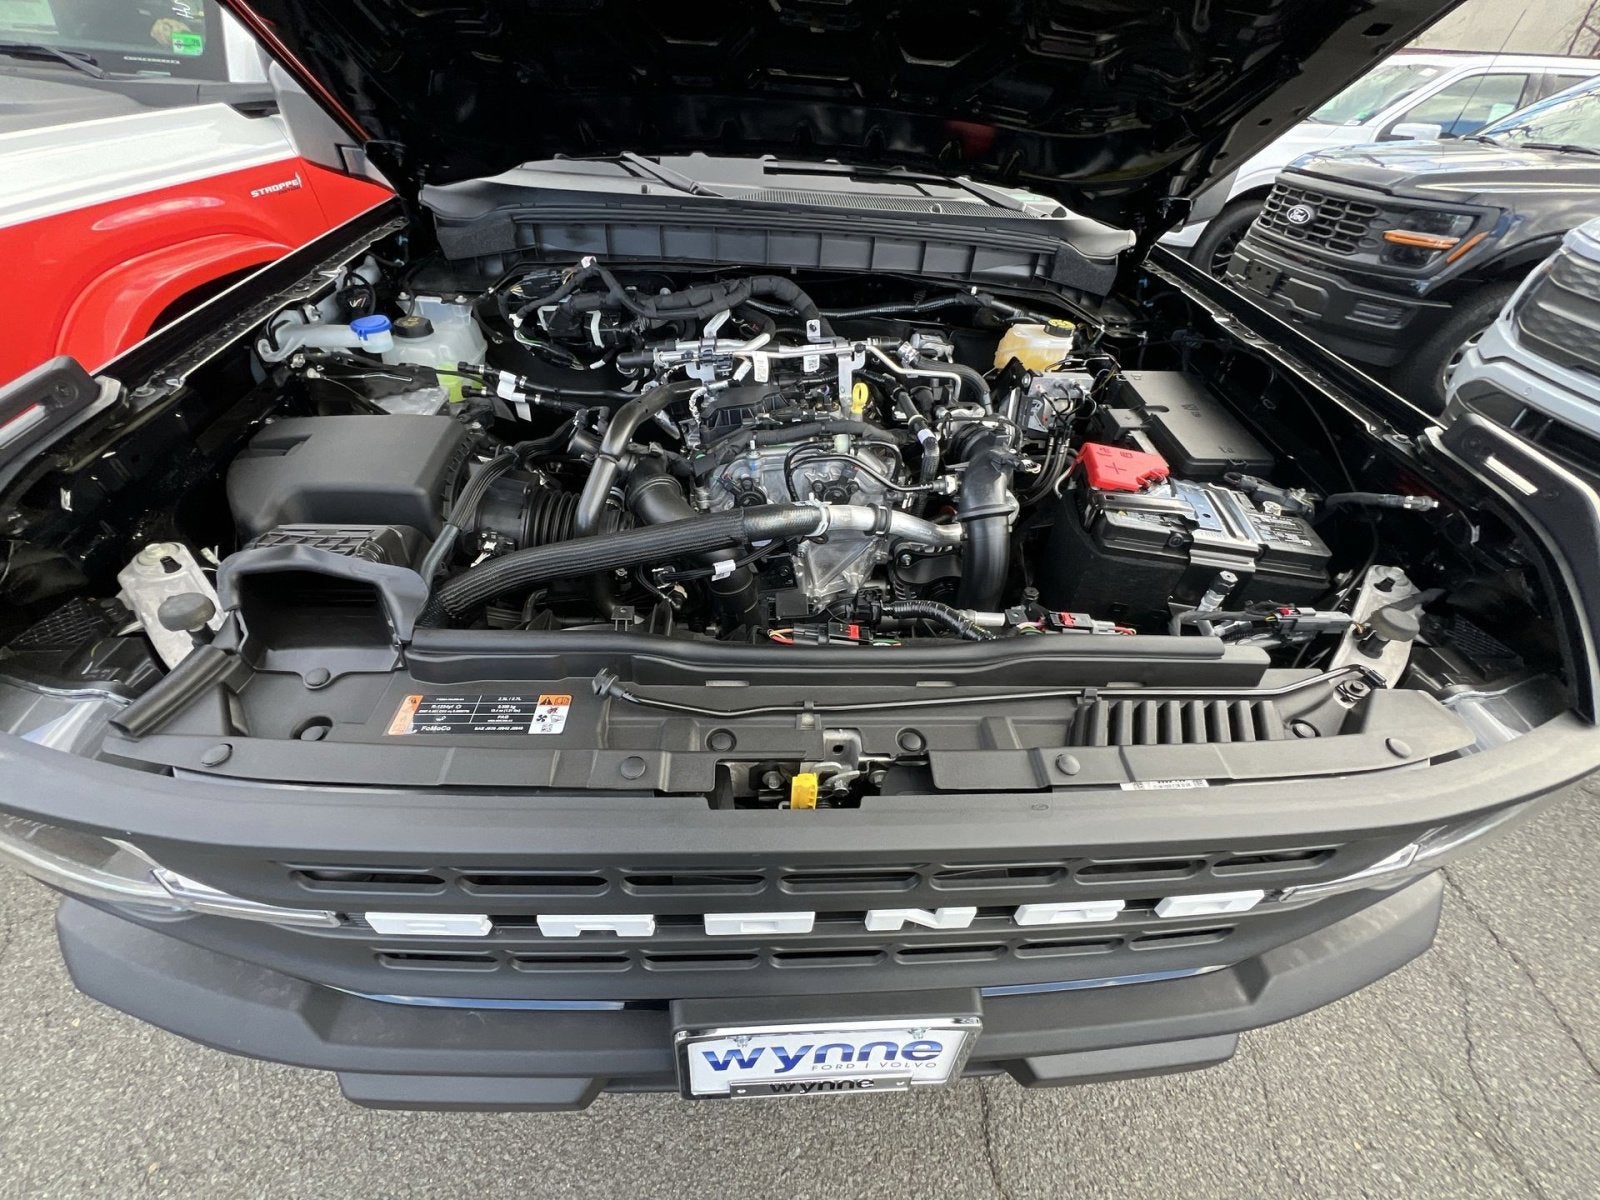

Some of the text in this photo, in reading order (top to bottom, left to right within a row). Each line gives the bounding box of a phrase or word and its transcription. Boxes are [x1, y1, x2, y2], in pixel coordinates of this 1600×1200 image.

[250, 179, 299, 198] STROPPE
[702, 1040, 943, 1073] wynne
[811, 1063, 856, 1071] FORD
[878, 1061, 937, 1069] VOLVO
[769, 1078, 875, 1095] wynne
